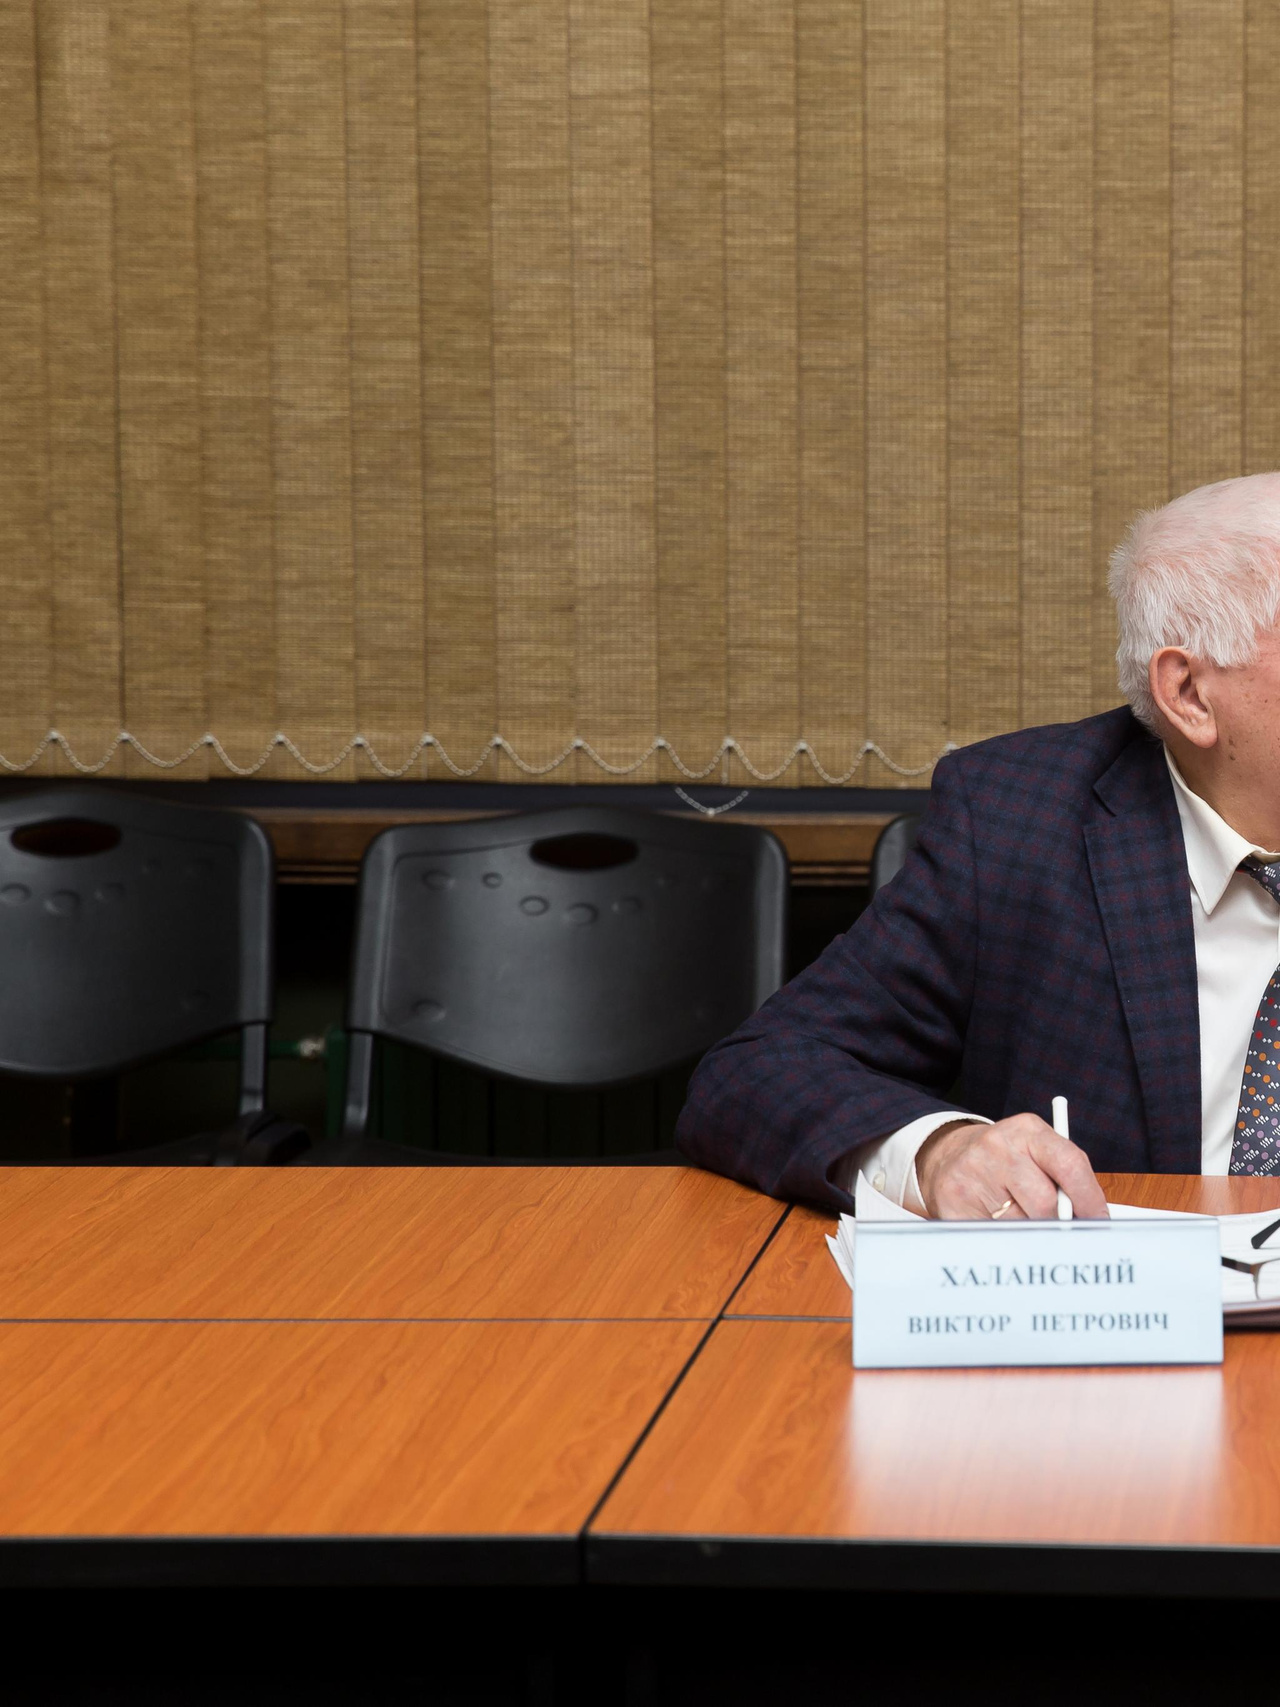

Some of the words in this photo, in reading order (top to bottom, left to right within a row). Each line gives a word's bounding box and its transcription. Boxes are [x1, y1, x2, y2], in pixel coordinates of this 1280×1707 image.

[941, 1258, 1136, 1287] ХАЛАНСКИЙ
[908, 1315, 1012, 1334] ВИКТОР
[1031, 1313, 1170, 1332] ПЕТРОВИЧ
